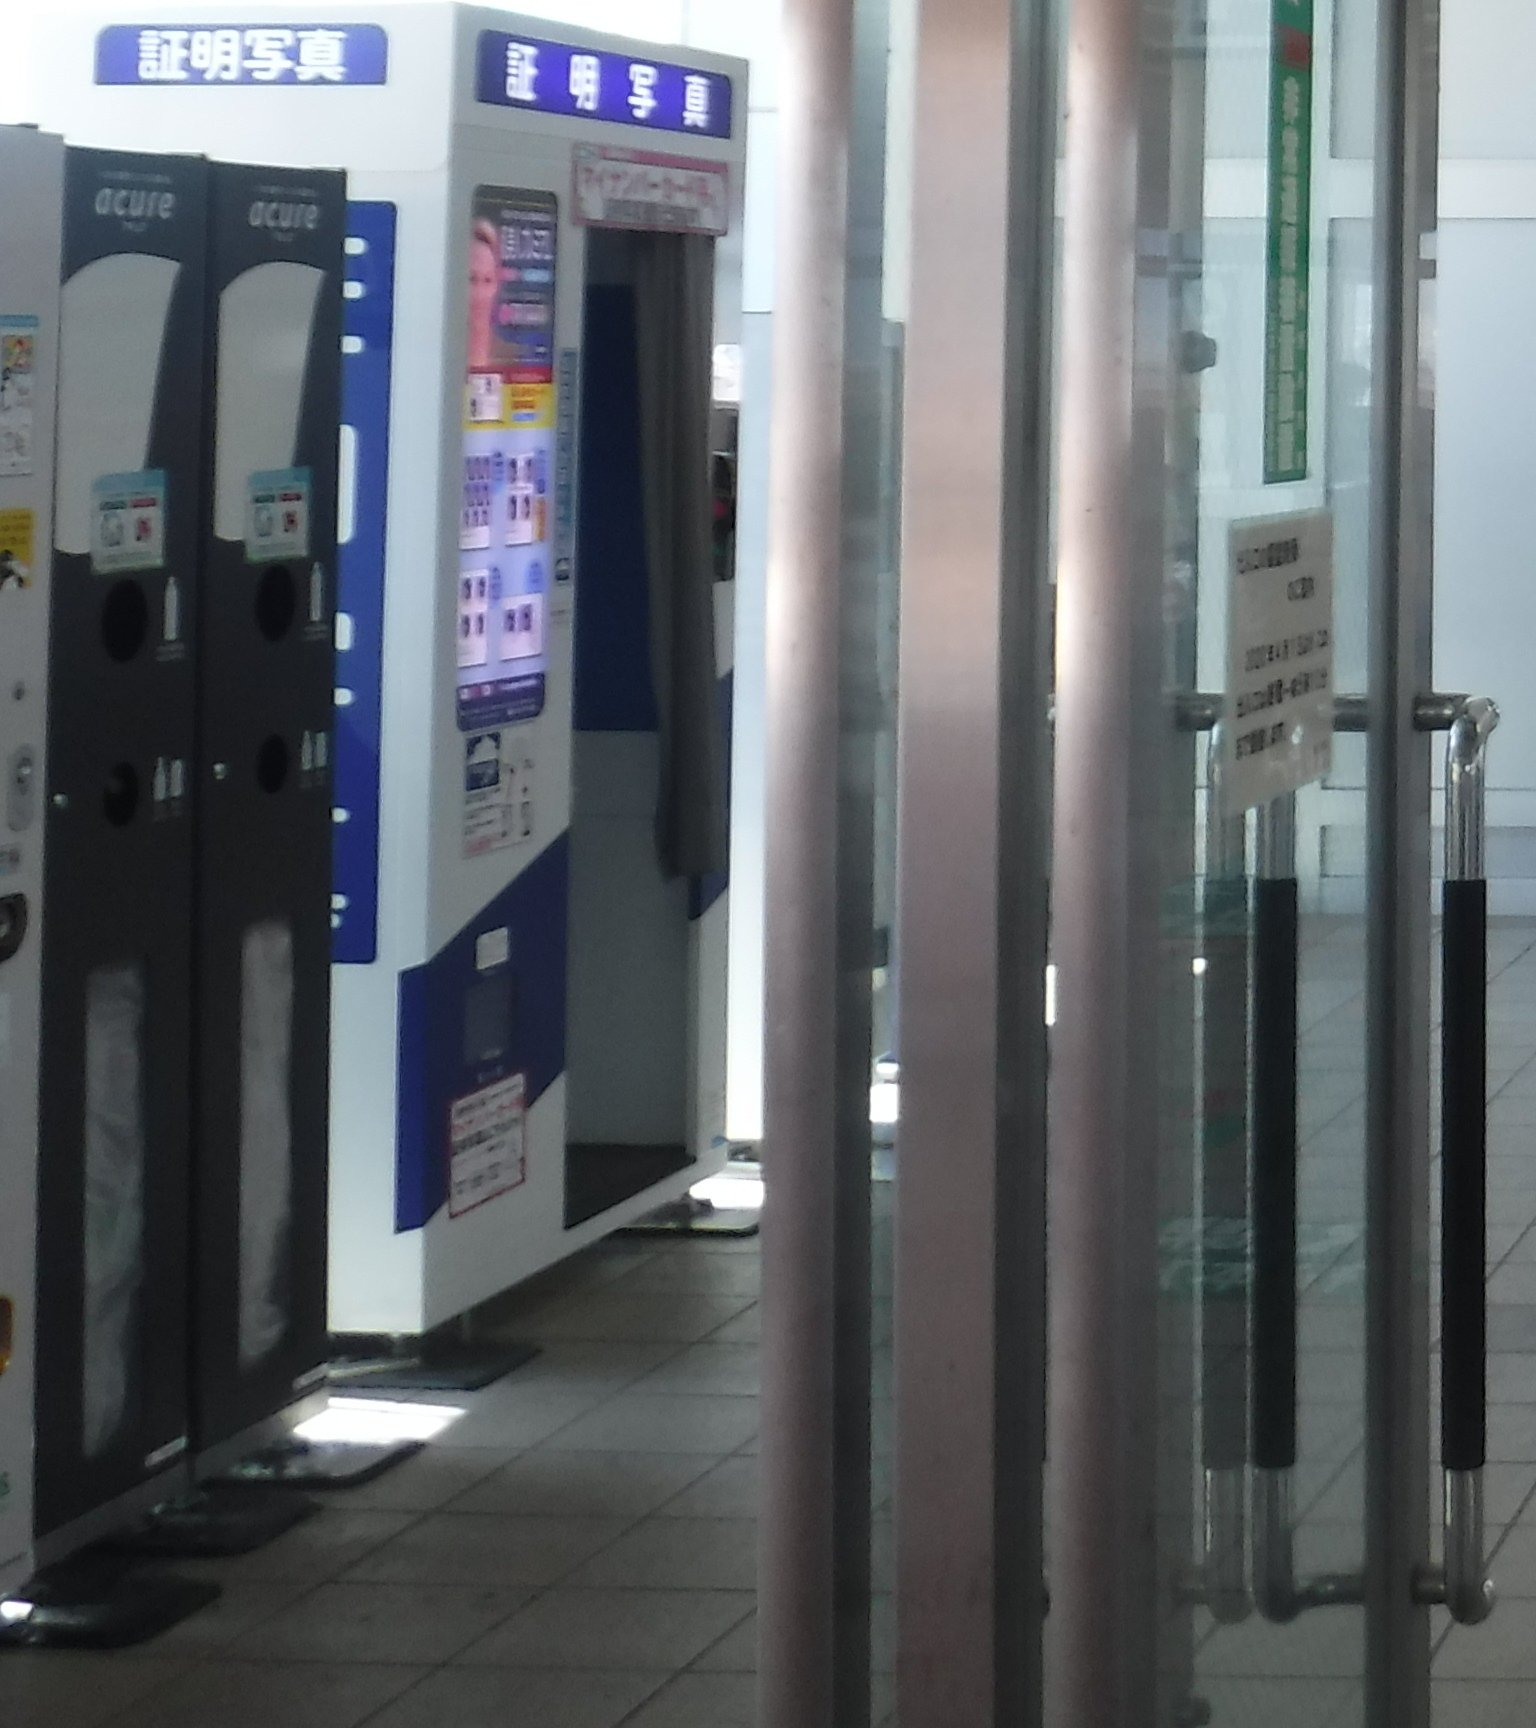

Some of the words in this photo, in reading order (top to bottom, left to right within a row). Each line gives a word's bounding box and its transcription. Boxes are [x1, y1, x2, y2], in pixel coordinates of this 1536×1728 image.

[137, 28, 347, 82] 証明写真
[505, 41, 712, 129] 証明写真
[95, 187, 176, 220] acure
[249, 200, 319, 230] acure
